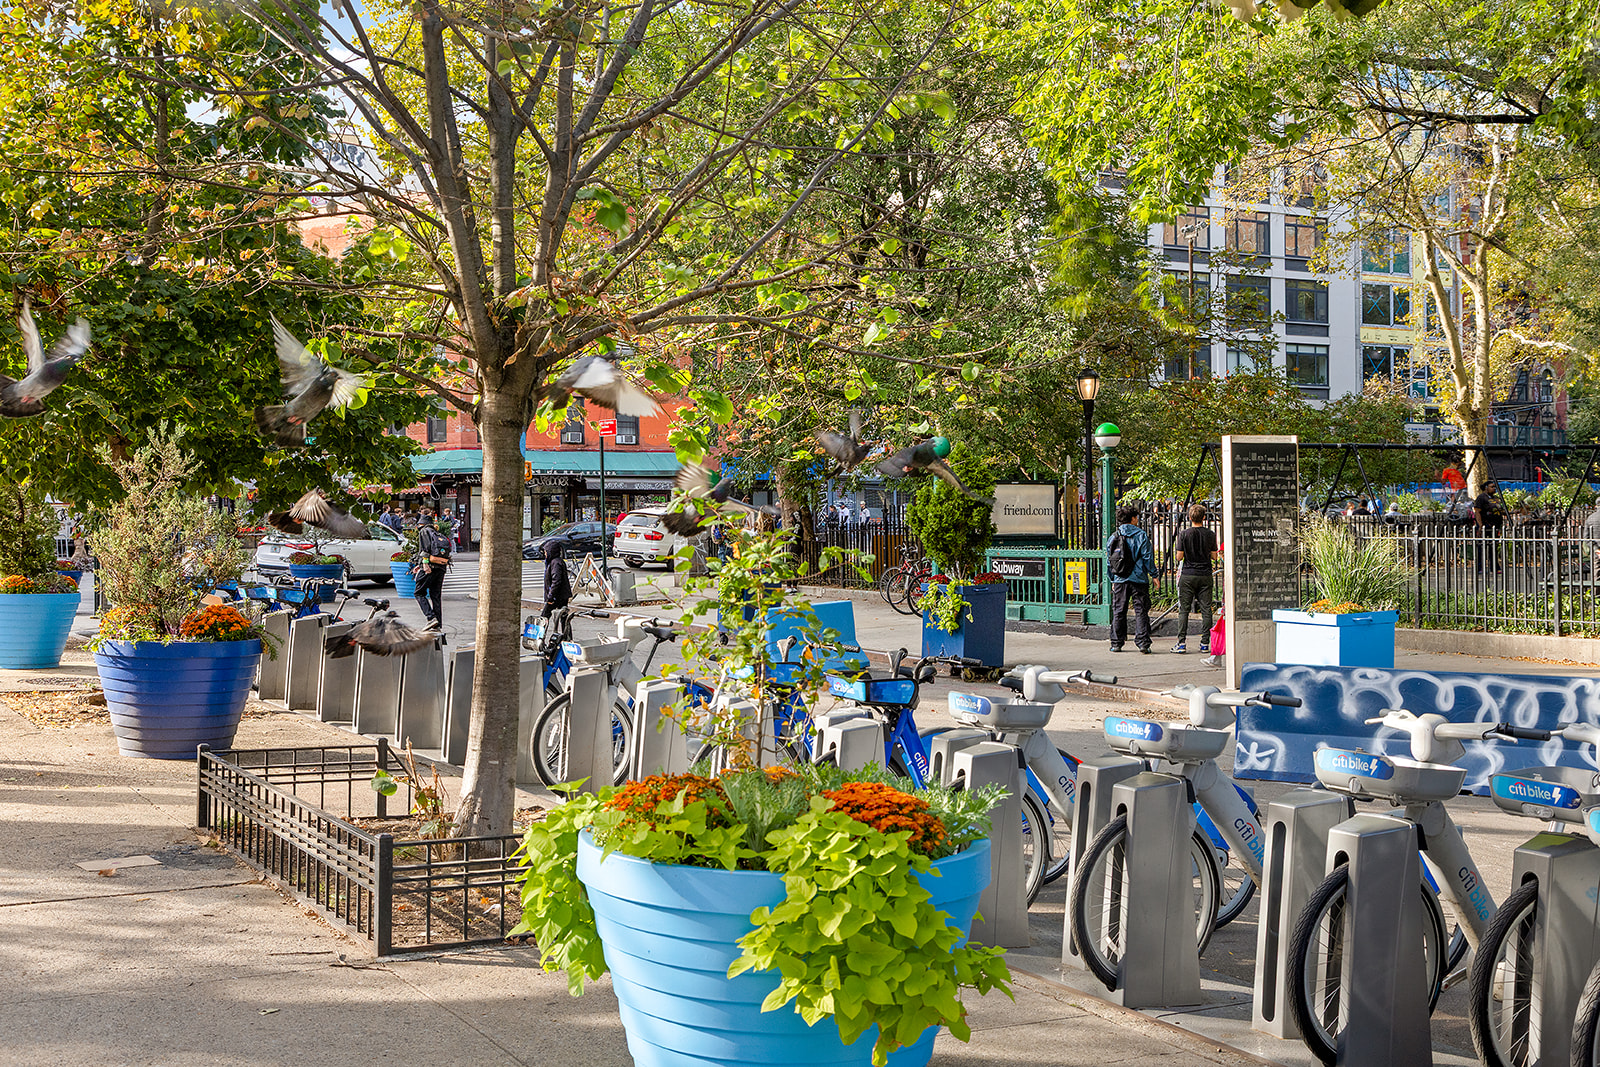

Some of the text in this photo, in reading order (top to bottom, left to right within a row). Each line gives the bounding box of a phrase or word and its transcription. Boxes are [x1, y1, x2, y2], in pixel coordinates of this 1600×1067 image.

[1004, 504, 1053, 516] friend.com
[992, 561, 1024, 576] Subway
[914, 752, 927, 770] citi
[1332, 754, 1369, 772] citi bike
[1058, 775, 1076, 796] citi
[1509, 782, 1551, 800] citi bike
[1233, 818, 1255, 841] citi
[1458, 866, 1489, 922] citi bike
